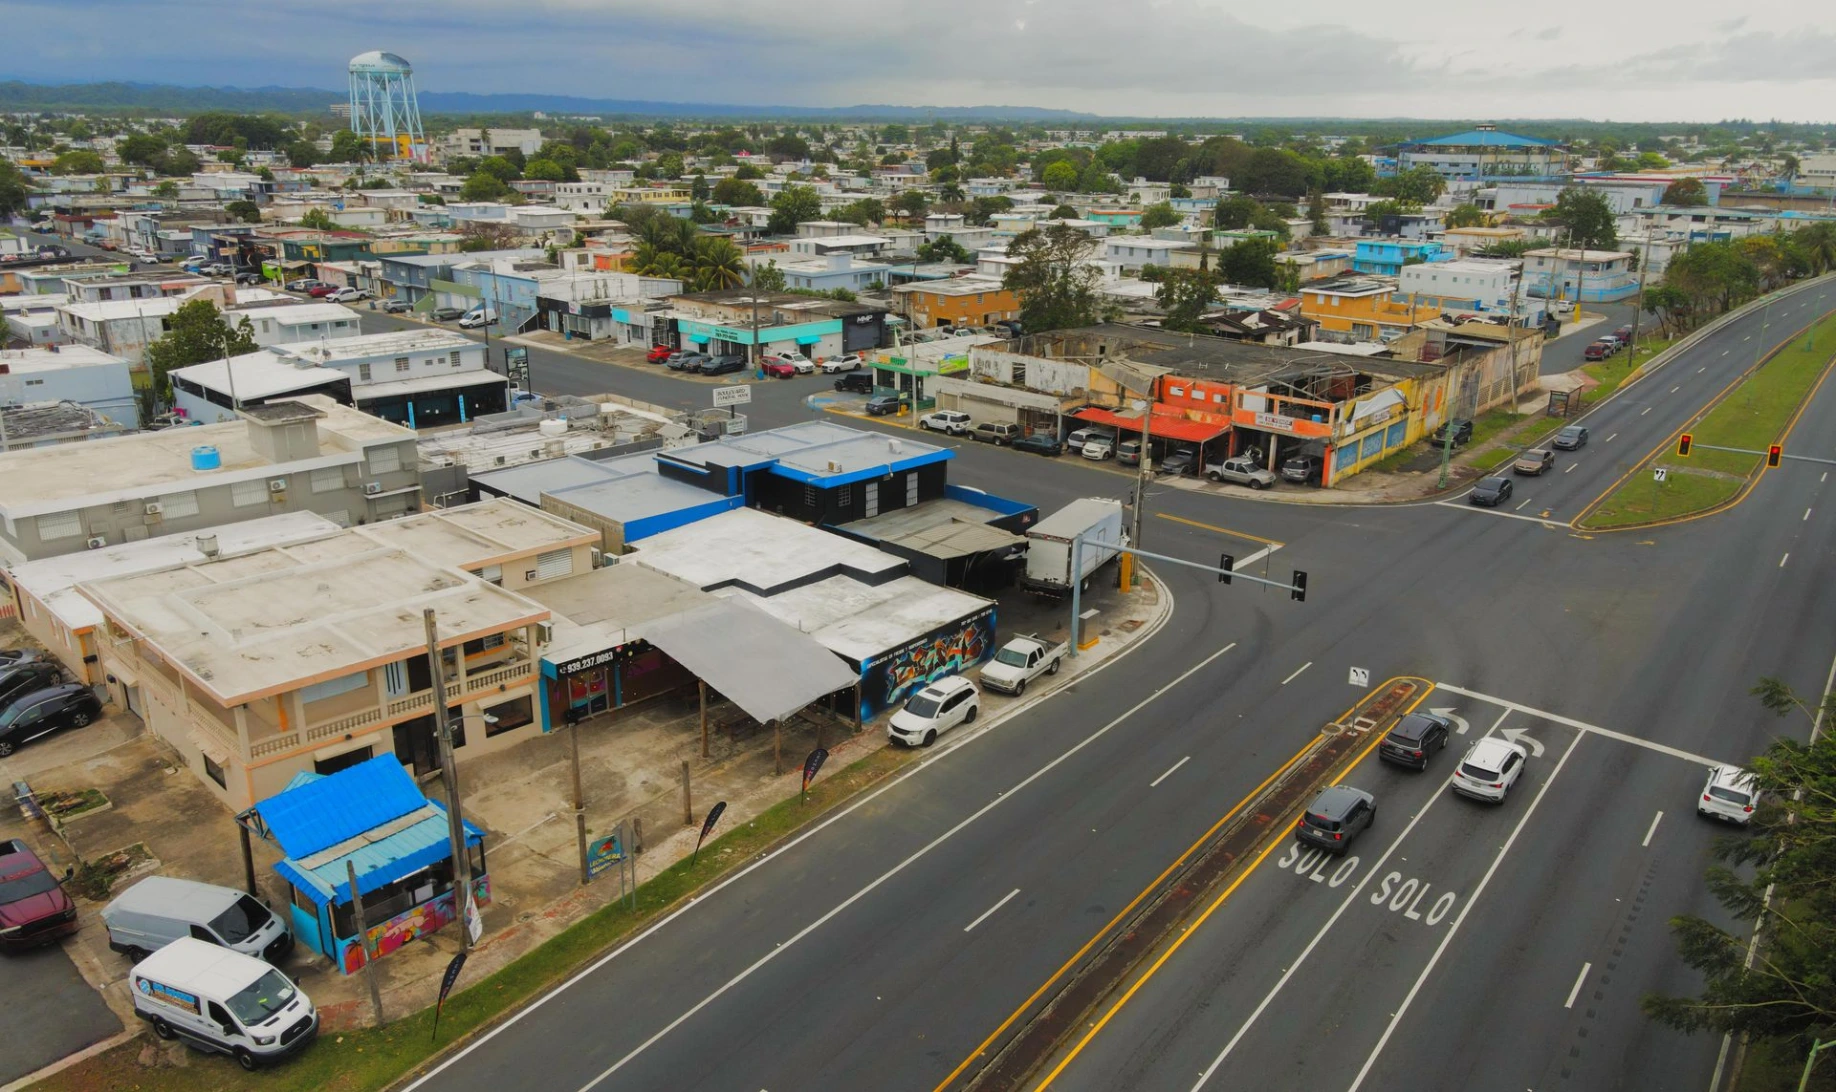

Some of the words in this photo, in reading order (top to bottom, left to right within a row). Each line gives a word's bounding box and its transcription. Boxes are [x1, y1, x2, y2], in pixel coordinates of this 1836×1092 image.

[717, 388, 746, 396] BOULEVARD
[567, 651, 614, 674] 939.237.0093
[1278, 841, 1360, 888] SOLO
[1370, 871, 1456, 926] SOLO
